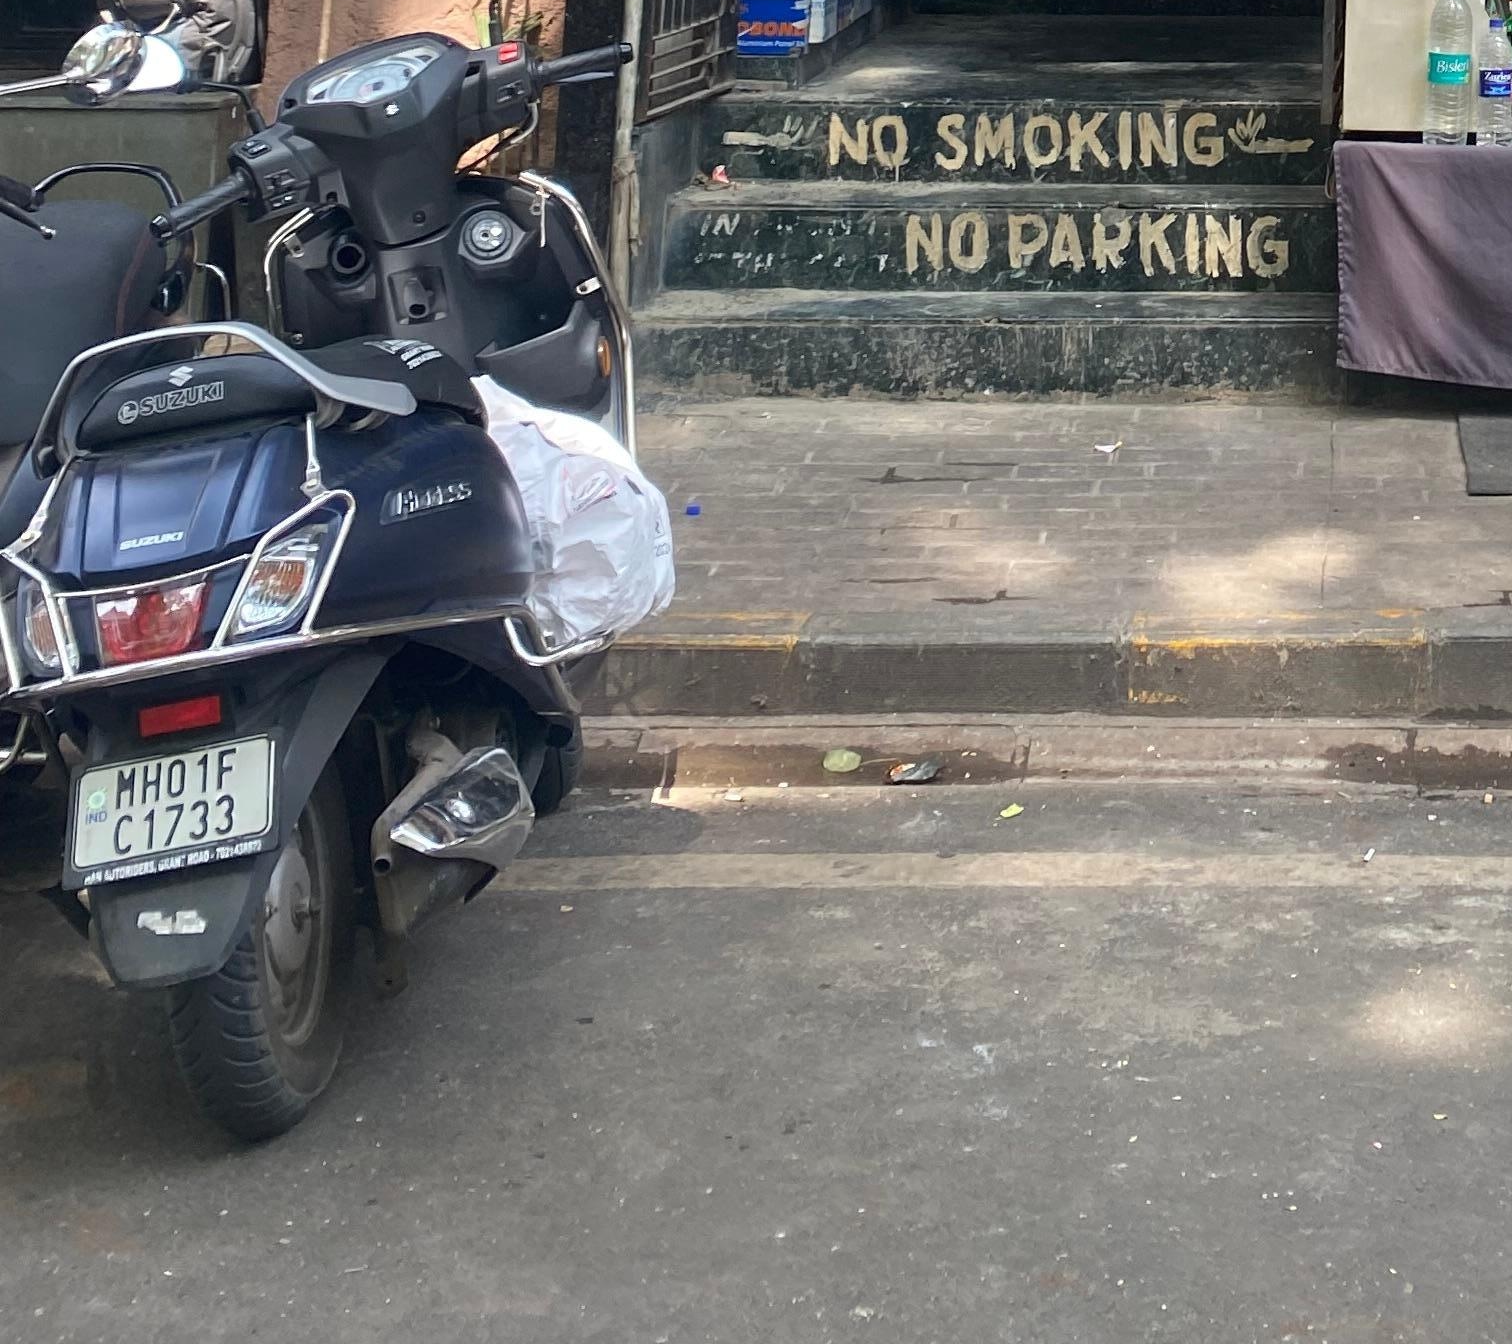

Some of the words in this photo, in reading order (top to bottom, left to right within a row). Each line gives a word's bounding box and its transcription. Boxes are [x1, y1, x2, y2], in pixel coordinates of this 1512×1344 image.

[829, 113, 908, 168] NO
[935, 112, 1224, 171] SMOKING
[905, 214, 989, 275] NO
[1007, 213, 1289, 278] PARKING
[140, 381, 224, 416] SUZUKI
[120, 531, 184, 551] SUZUKI
[86, 811, 108, 824] IND
[114, 795, 235, 855] C1733
